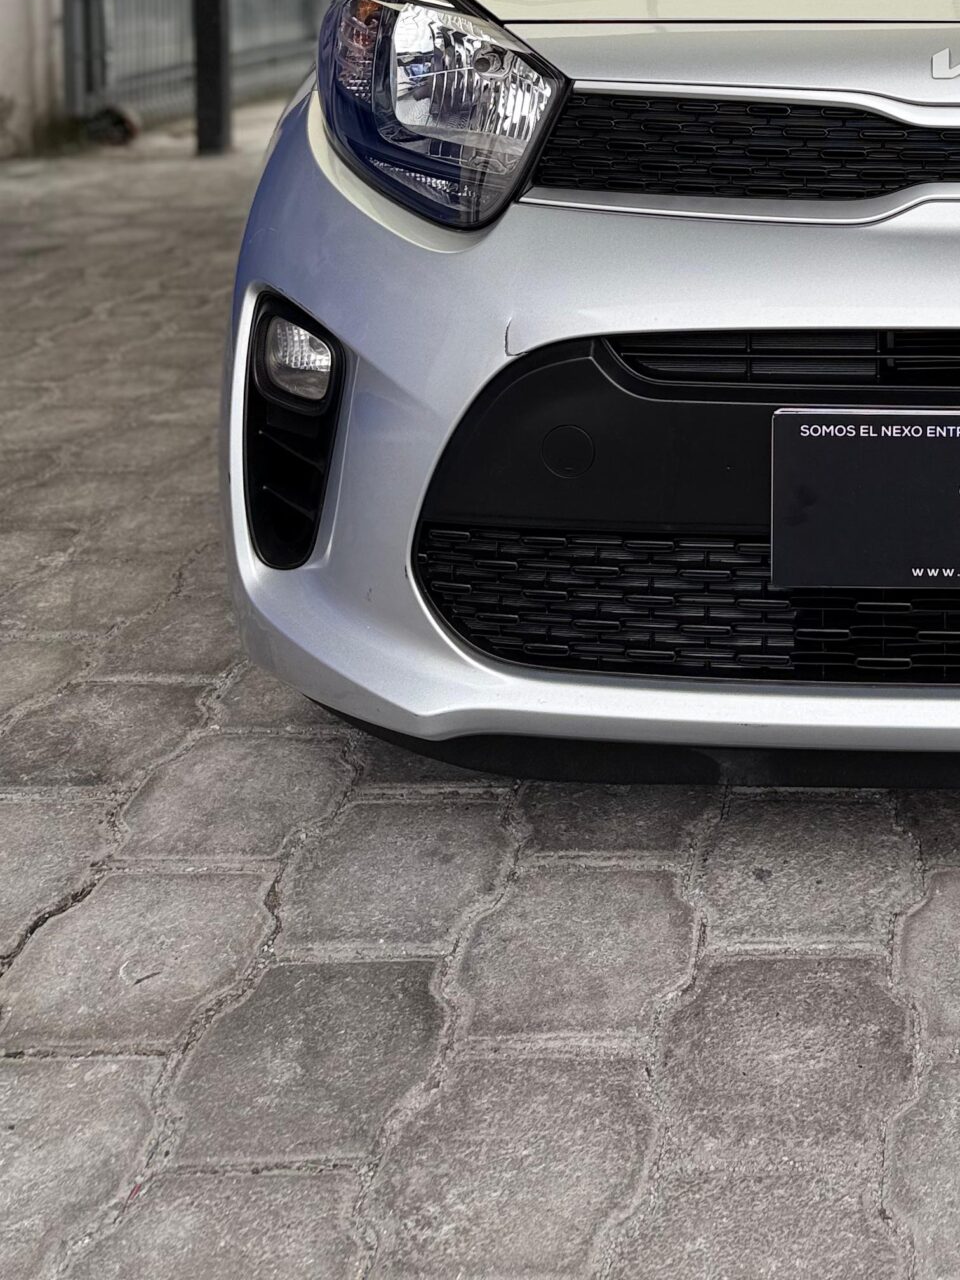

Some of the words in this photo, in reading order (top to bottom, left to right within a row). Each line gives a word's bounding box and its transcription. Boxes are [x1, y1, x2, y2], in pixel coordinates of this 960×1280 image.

[799, 423, 856, 438] SOMOS
[859, 424, 878, 438] EL
[881, 424, 923, 439] NEXO
